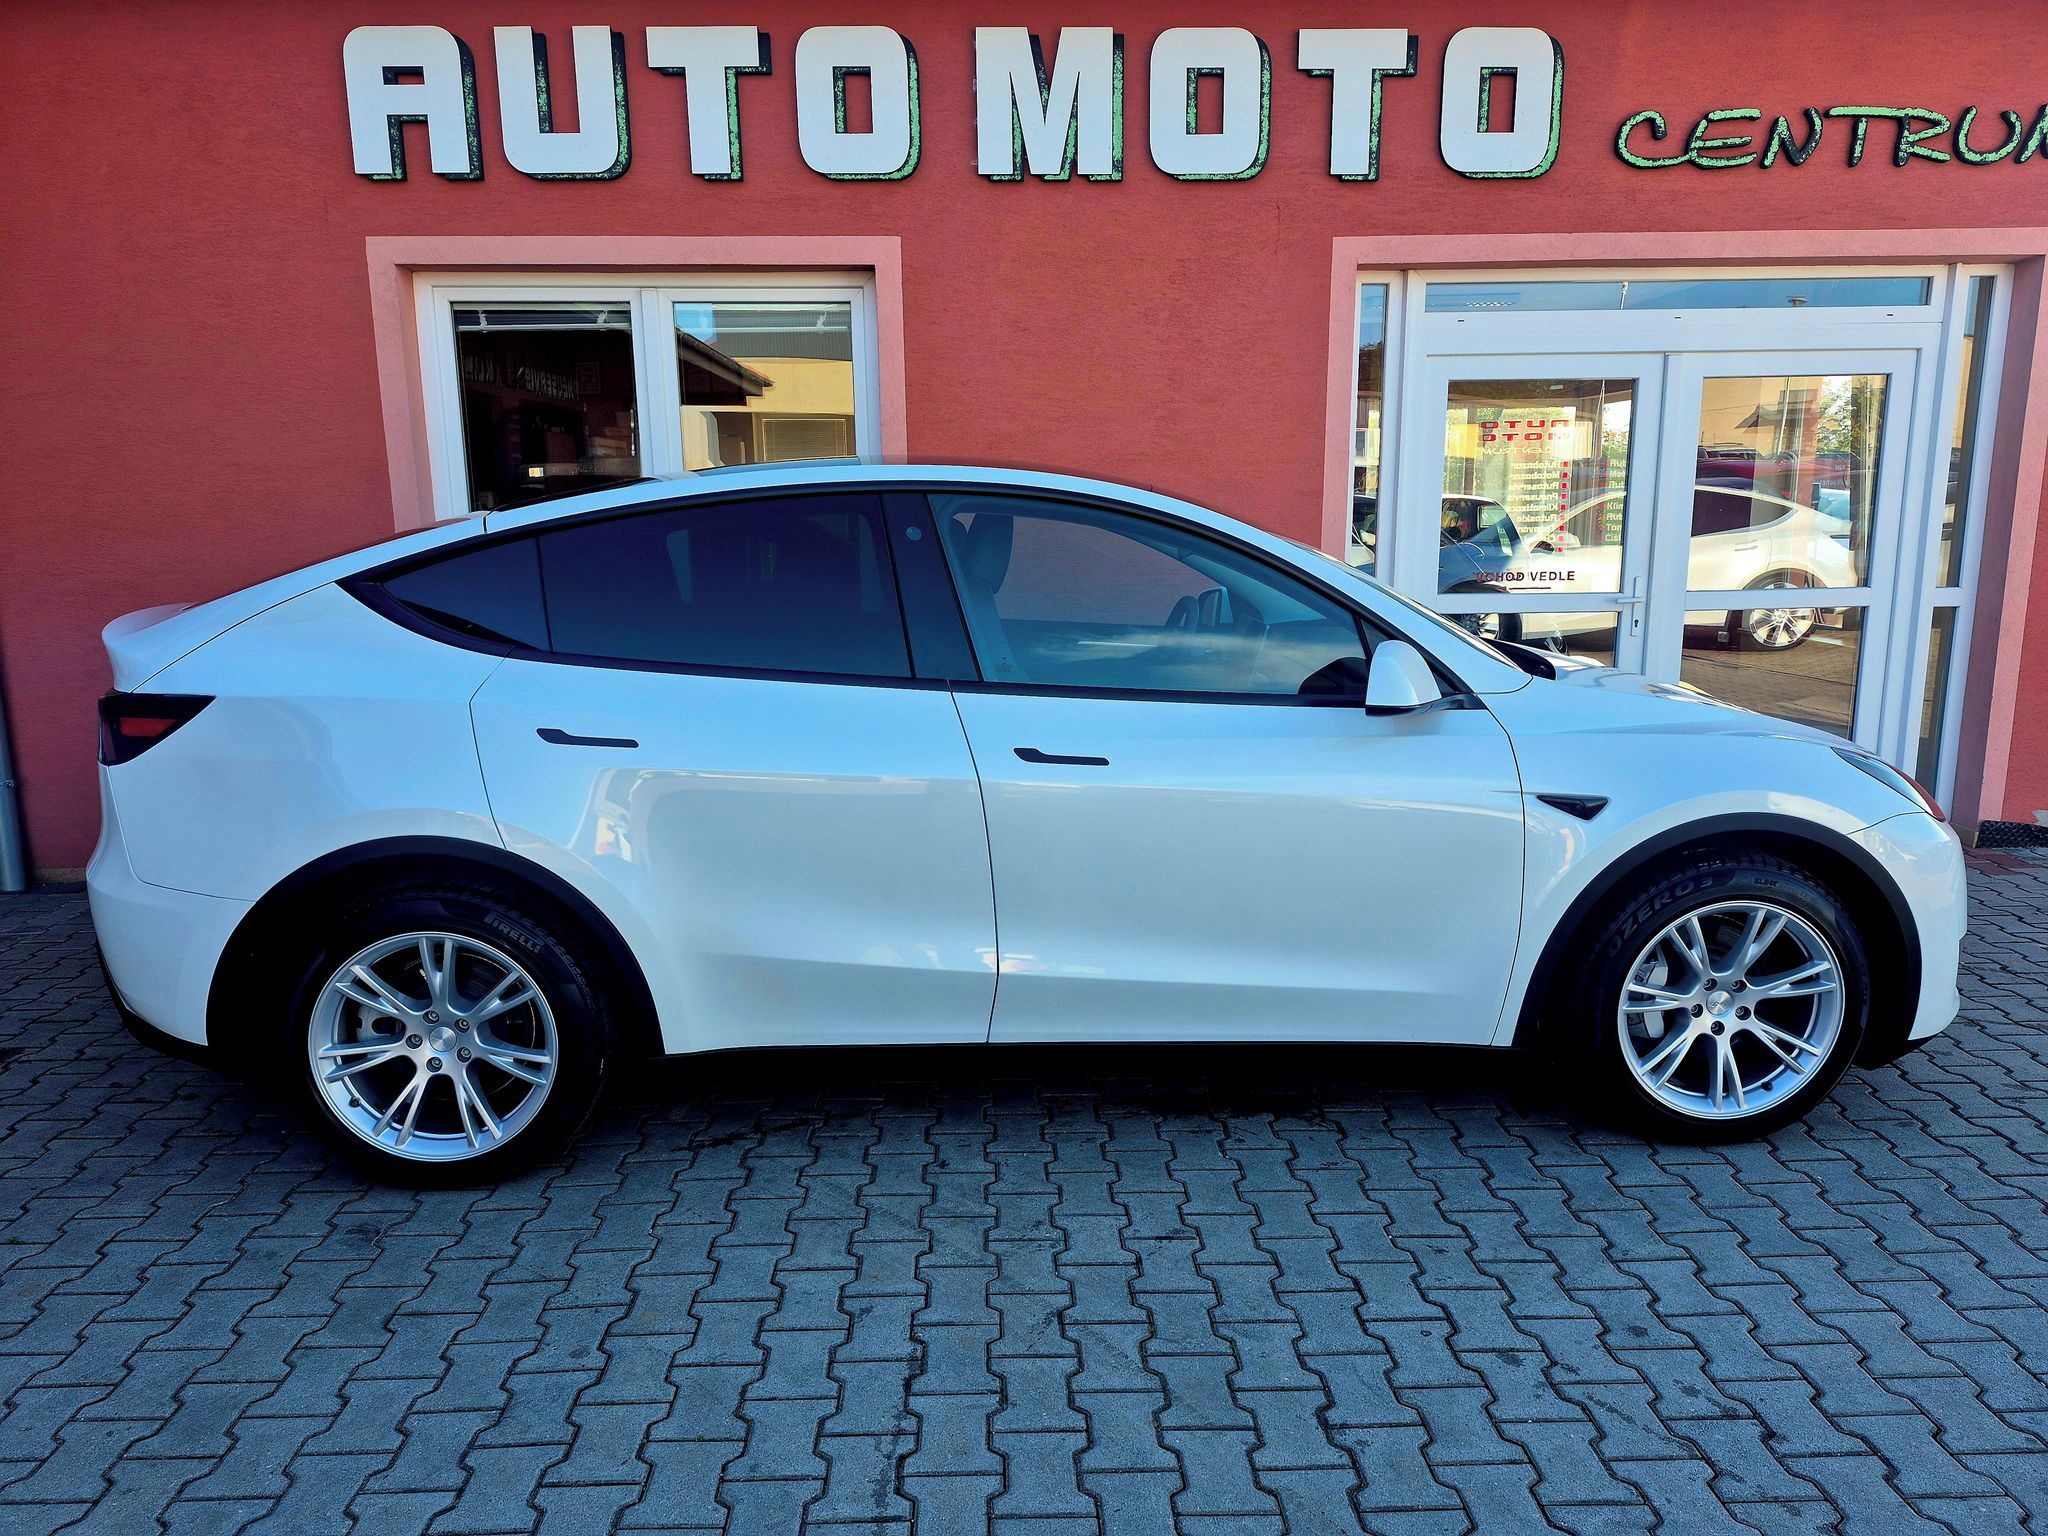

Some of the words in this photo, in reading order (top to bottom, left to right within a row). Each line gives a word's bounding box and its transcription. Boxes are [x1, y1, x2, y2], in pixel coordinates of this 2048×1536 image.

[343, 25, 918, 182] AUTO
[974, 26, 1564, 182] MOTO
[1475, 571, 1525, 583] VCHOD
[1530, 570, 1575, 582] VEDLE
[483, 910, 545, 954] PIRELLI
